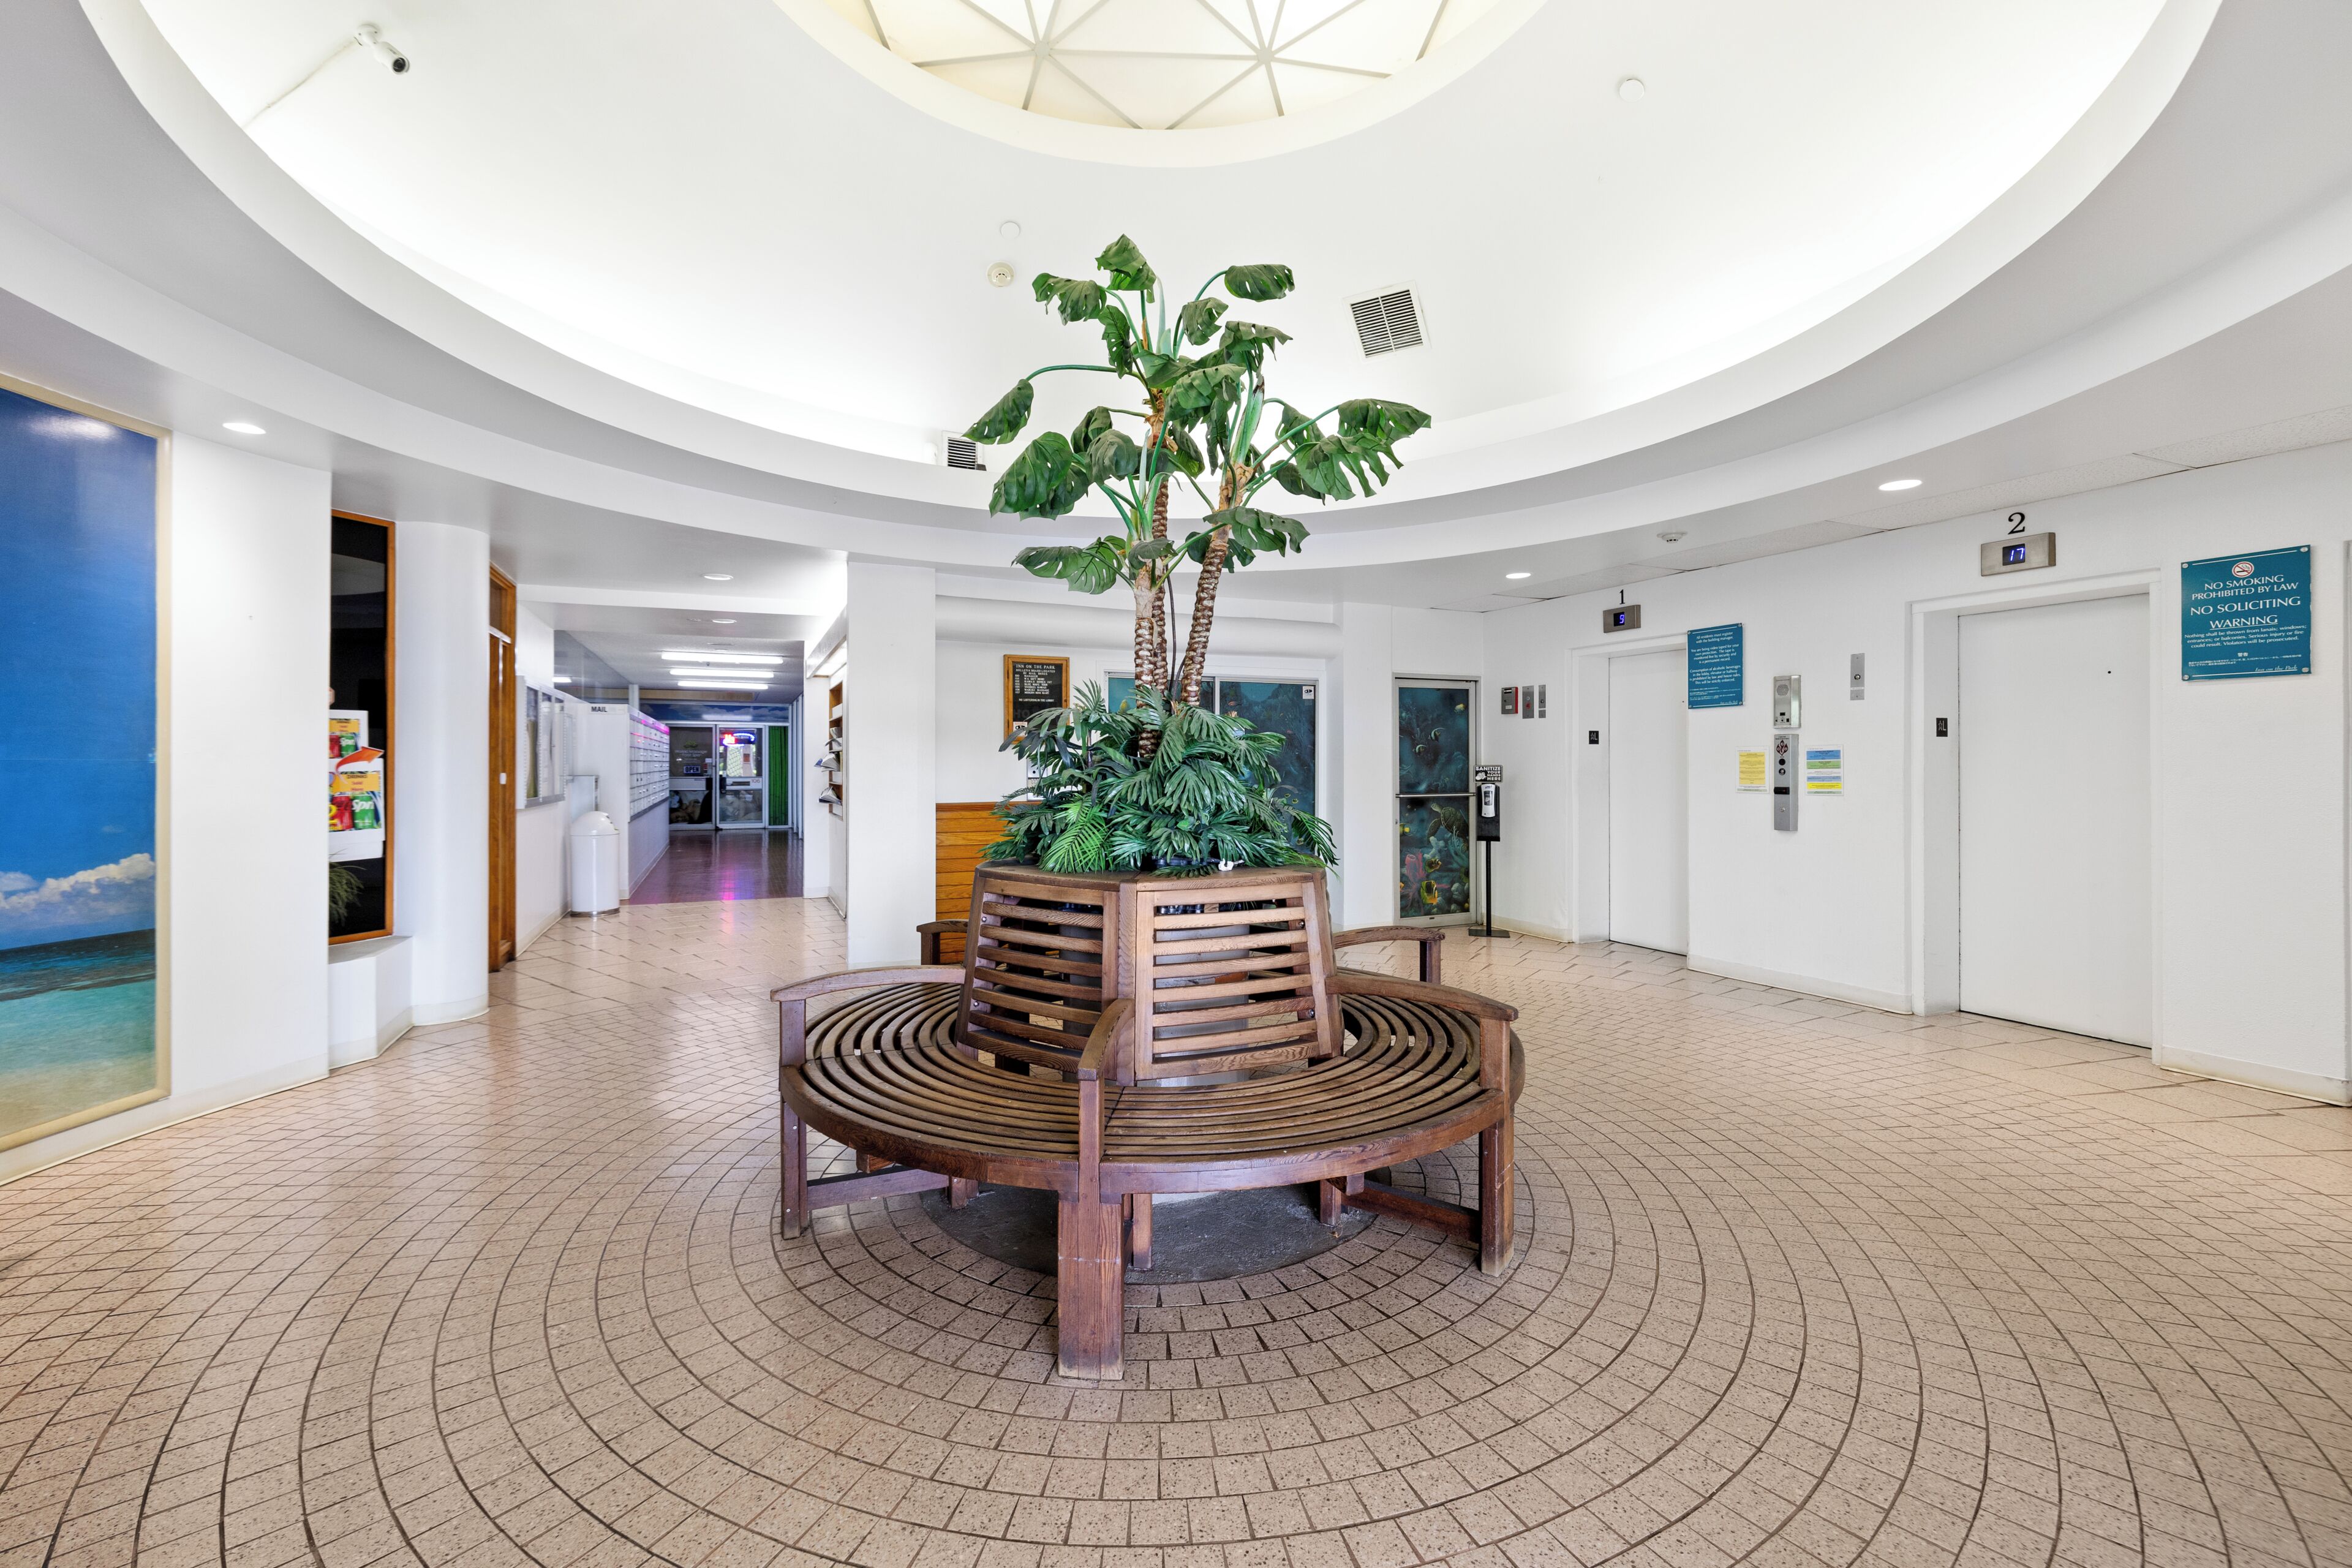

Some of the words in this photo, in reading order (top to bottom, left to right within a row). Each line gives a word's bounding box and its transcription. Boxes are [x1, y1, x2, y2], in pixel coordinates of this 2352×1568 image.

[2008, 512, 2026, 535] 2
[2010, 548, 2026, 561] 17
[2204, 581, 2223, 590] NO
[2226, 575, 2284, 587] SMOKING
[1619, 589, 1625, 605] 1
[2192, 587, 2255, 600] PROHIBITED
[2274, 582, 2299, 591] LAW
[2190, 605, 2213, 616] NO
[2217, 597, 2301, 613] SOLICITING
[1619, 614, 1624, 624] 9
[2209, 615, 2278, 628] WARNING
